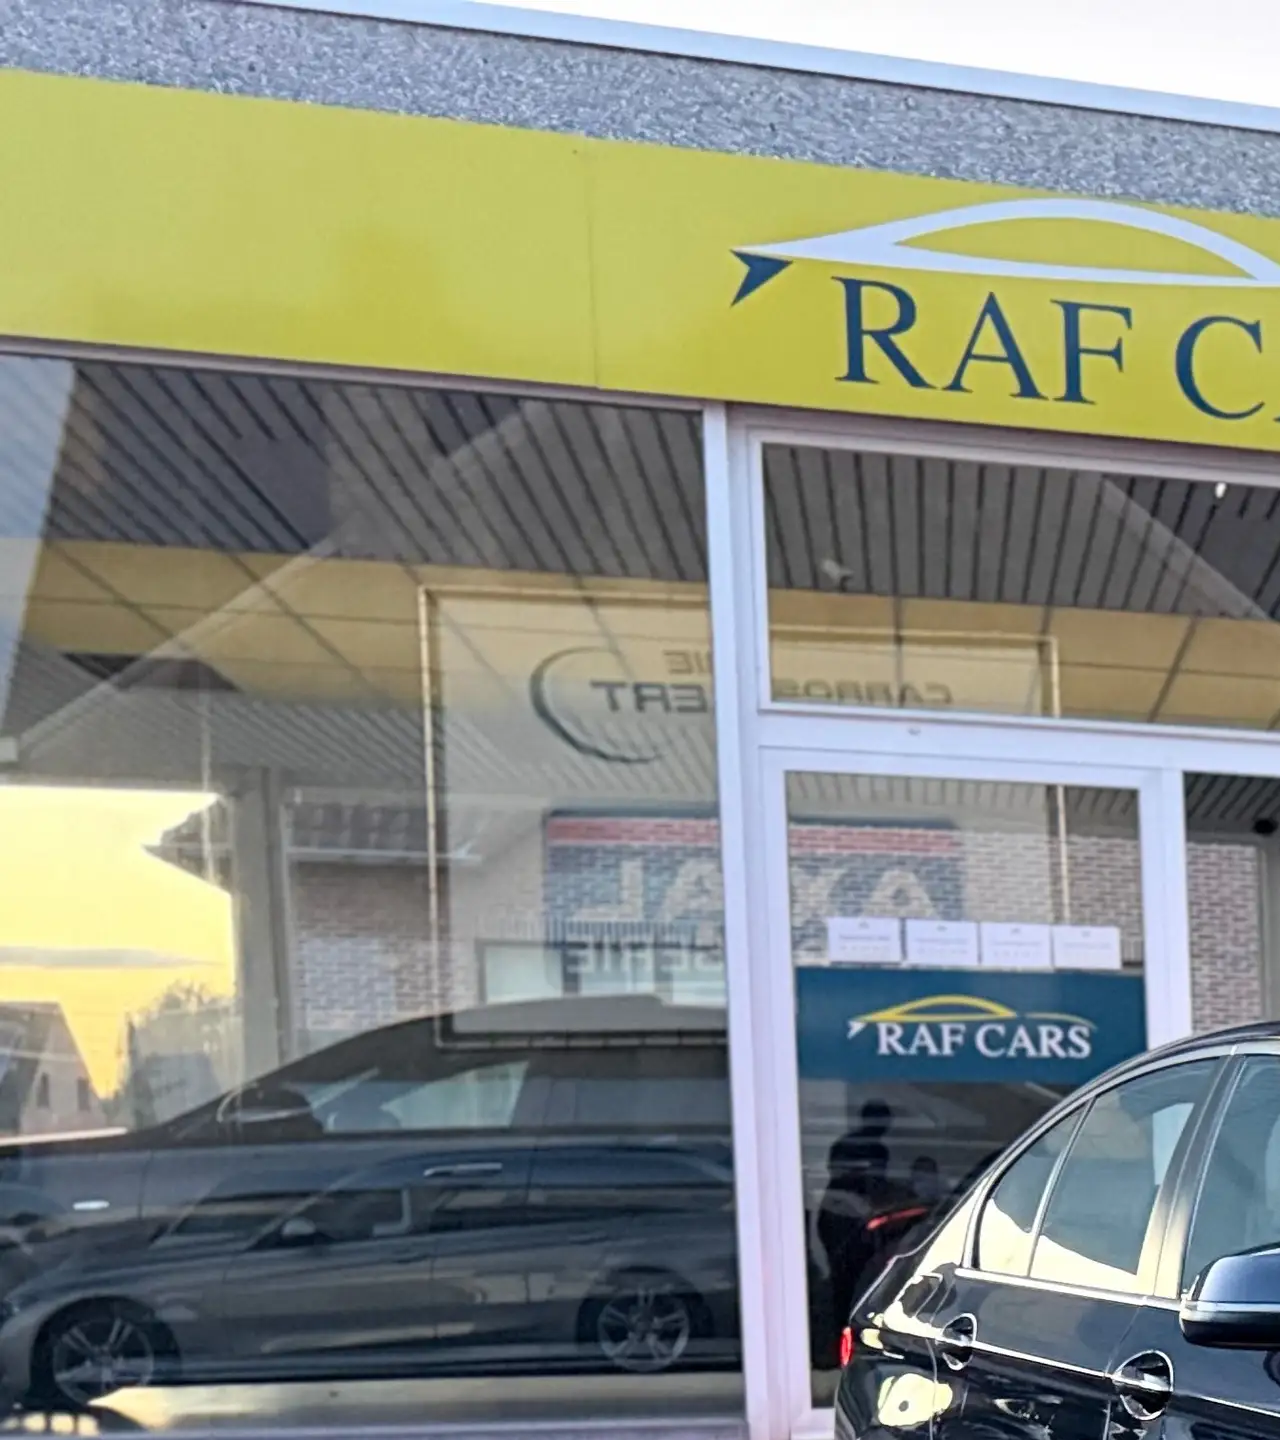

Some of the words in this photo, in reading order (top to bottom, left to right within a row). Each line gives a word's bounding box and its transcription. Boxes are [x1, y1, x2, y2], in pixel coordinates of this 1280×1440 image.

[831, 276, 1132, 405] RAF
[876, 1021, 967, 1057] RAF
[974, 1022, 1092, 1060] CARS
